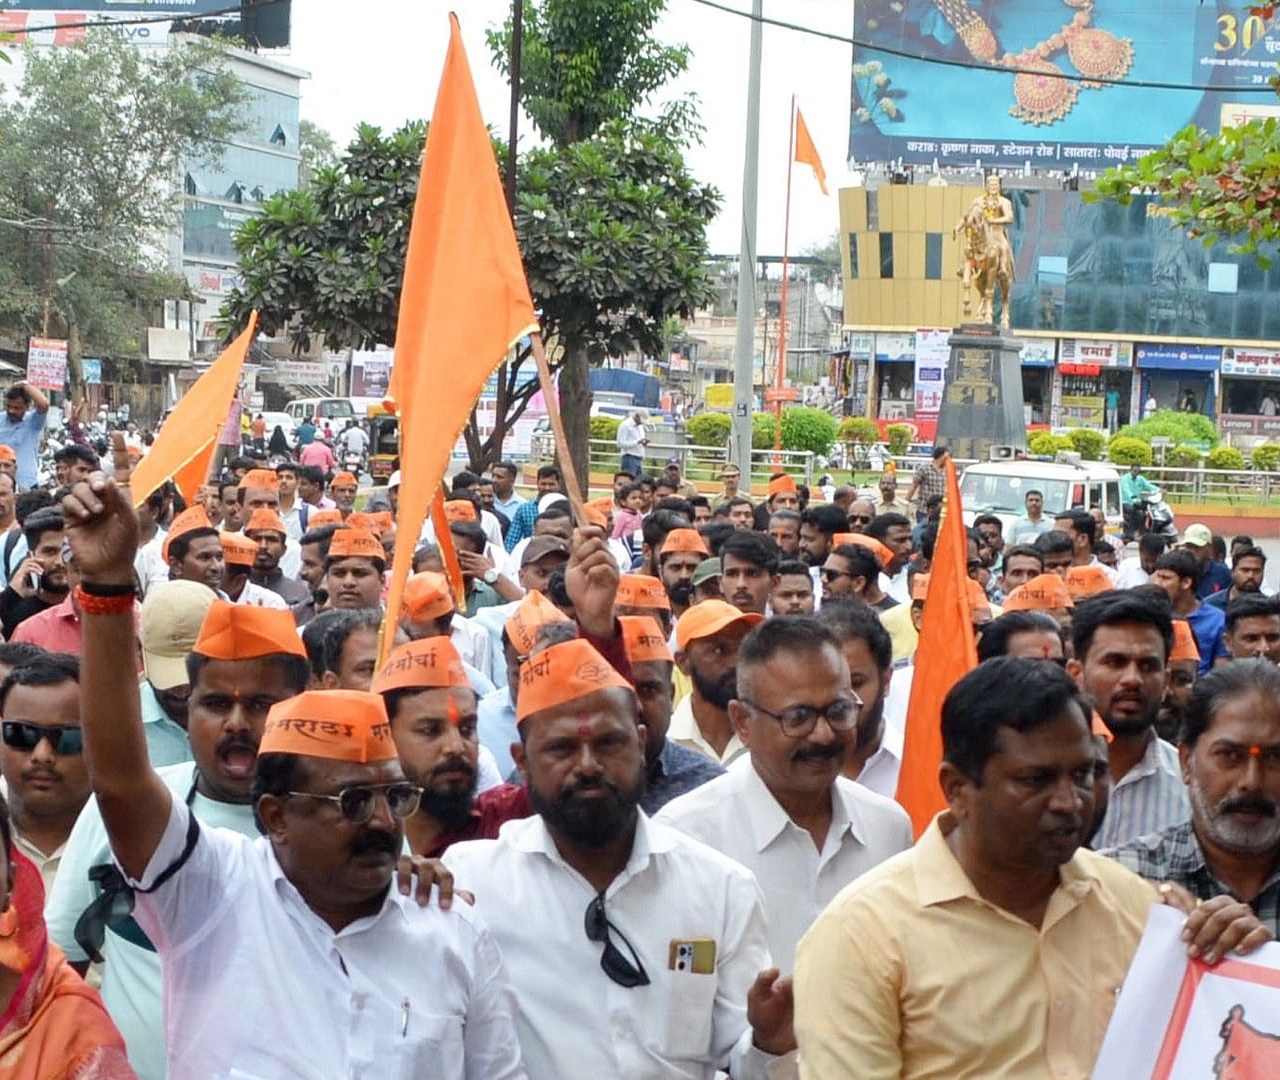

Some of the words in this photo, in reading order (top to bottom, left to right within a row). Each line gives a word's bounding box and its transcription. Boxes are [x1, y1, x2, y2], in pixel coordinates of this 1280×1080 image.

[1222, 419, 1252, 431] Lenovo
[394, 647, 437, 673] मोर्चा
[276, 717, 355, 744] मराठा
